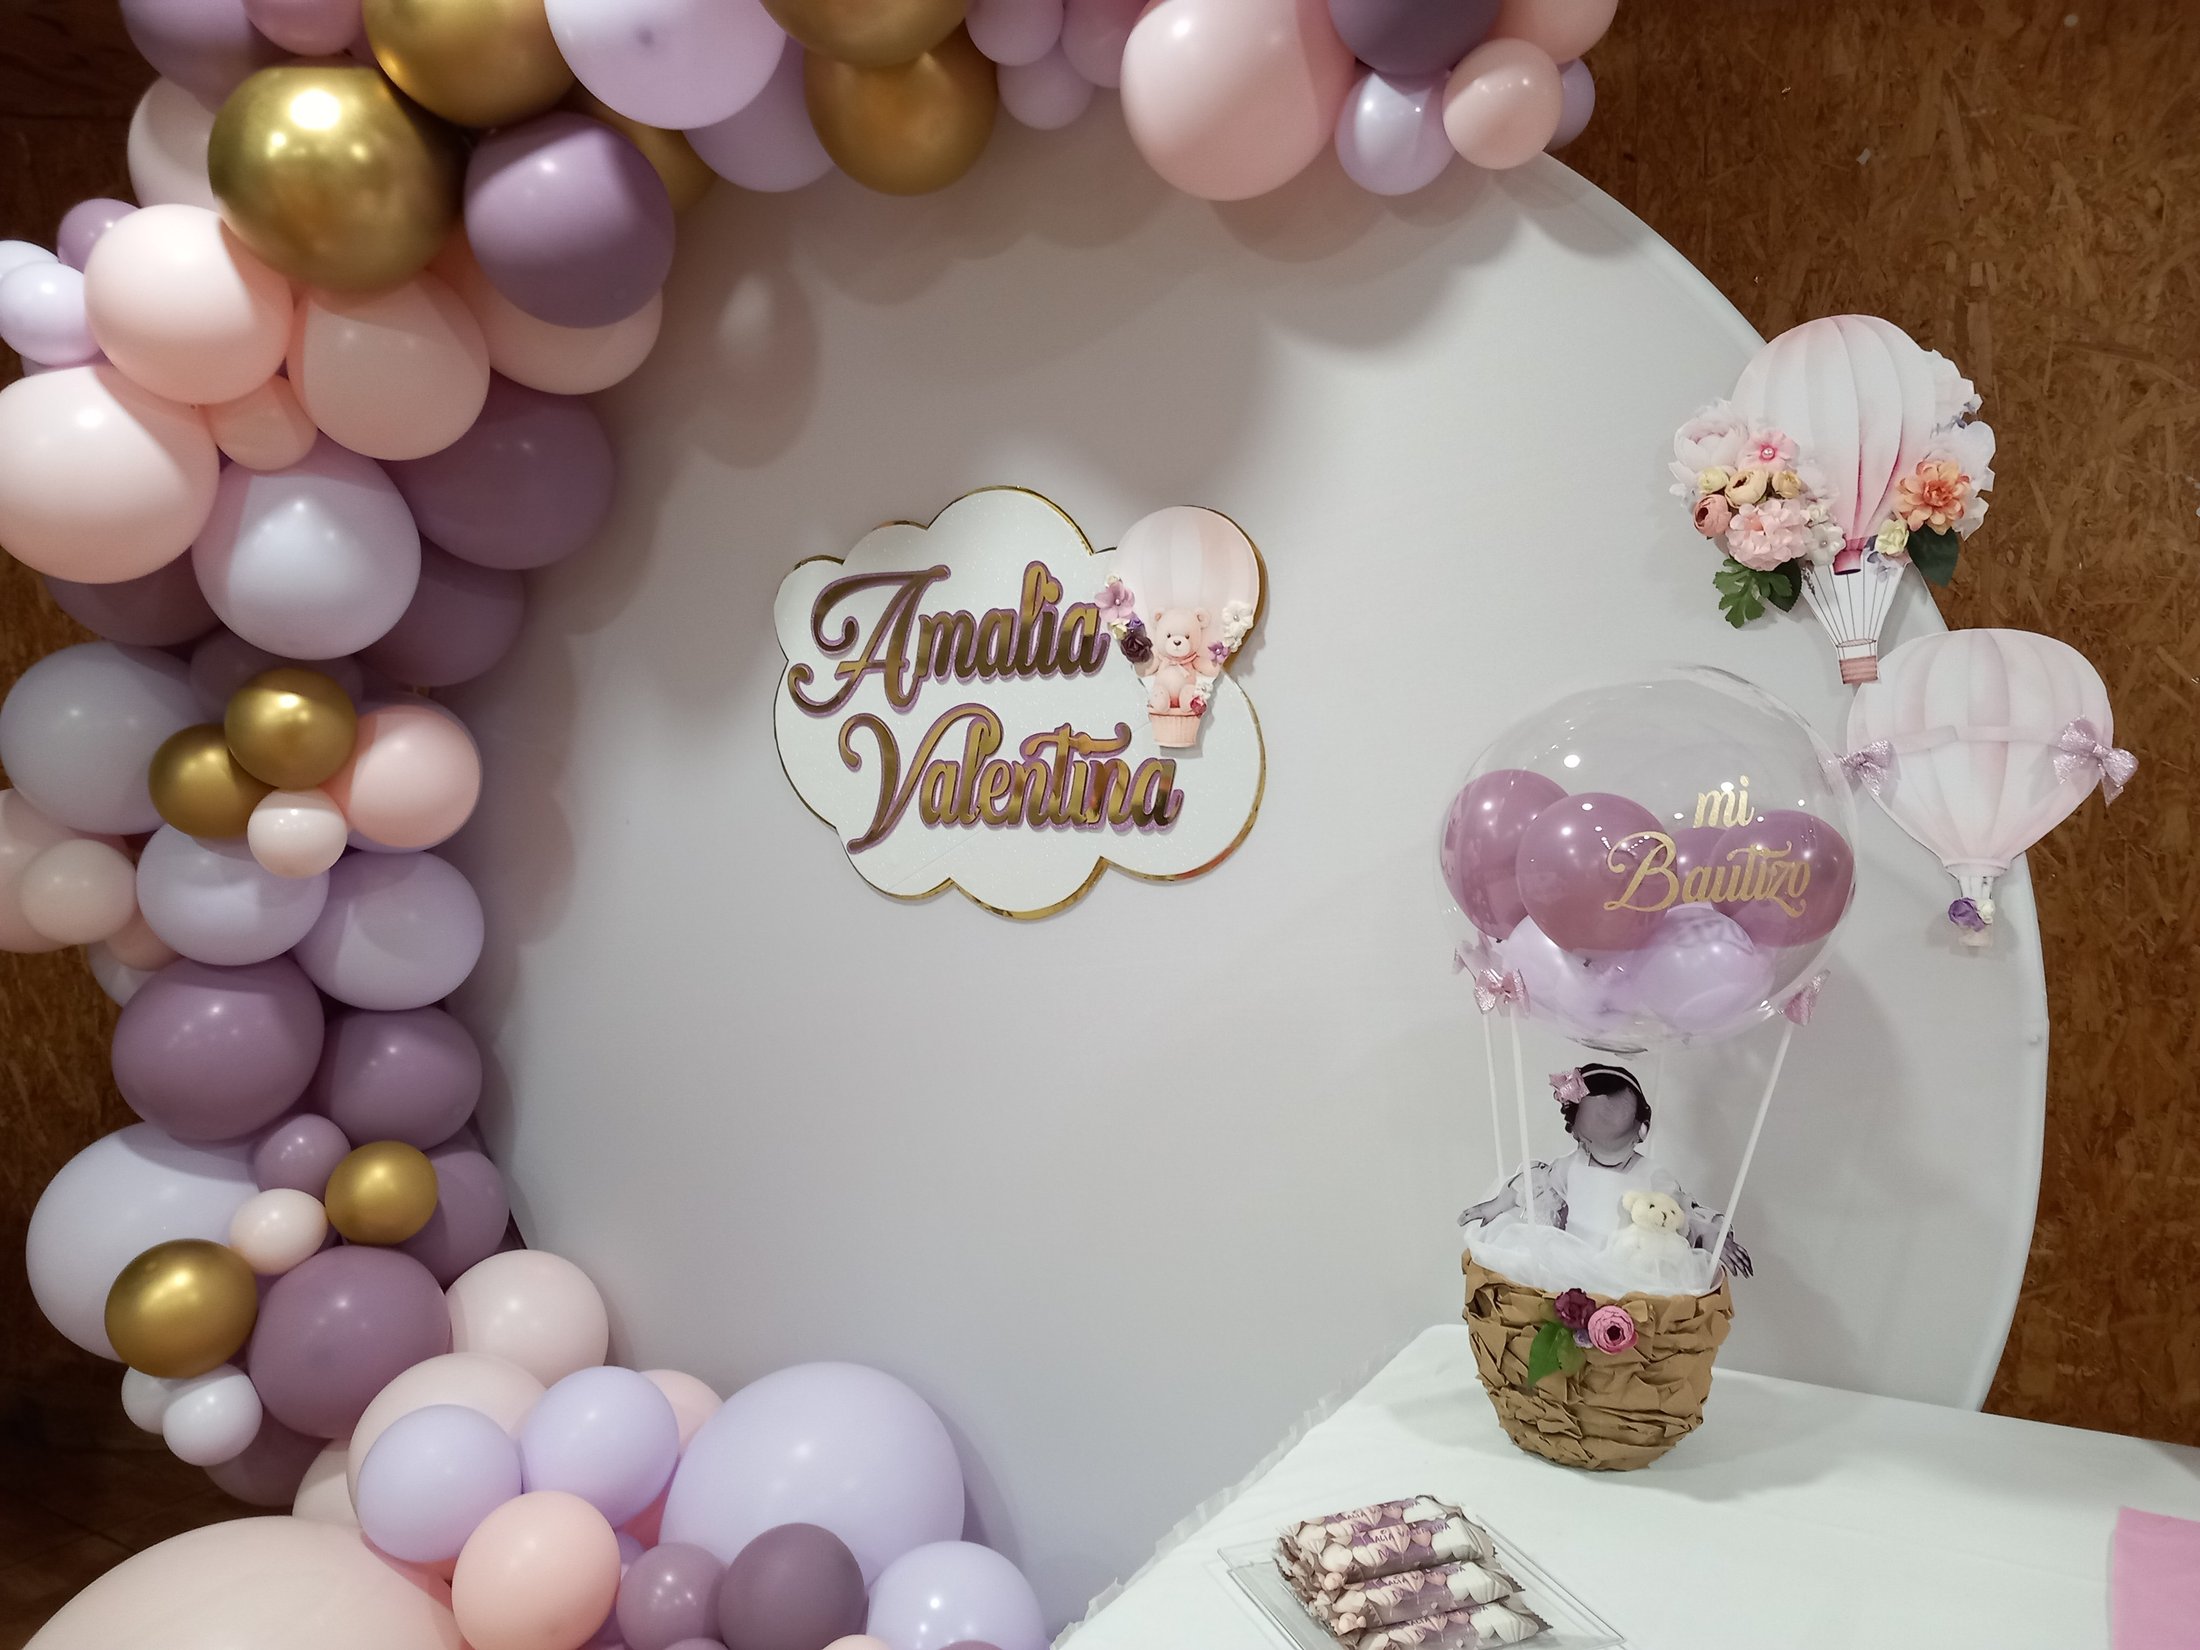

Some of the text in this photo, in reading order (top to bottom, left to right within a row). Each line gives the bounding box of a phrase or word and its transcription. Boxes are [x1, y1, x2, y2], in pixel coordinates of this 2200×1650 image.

[788, 560, 1111, 714] Amalia
[839, 703, 1184, 855] Valentina
[1693, 775, 1755, 828] mi
[1603, 831, 1811, 918] Bautizo
